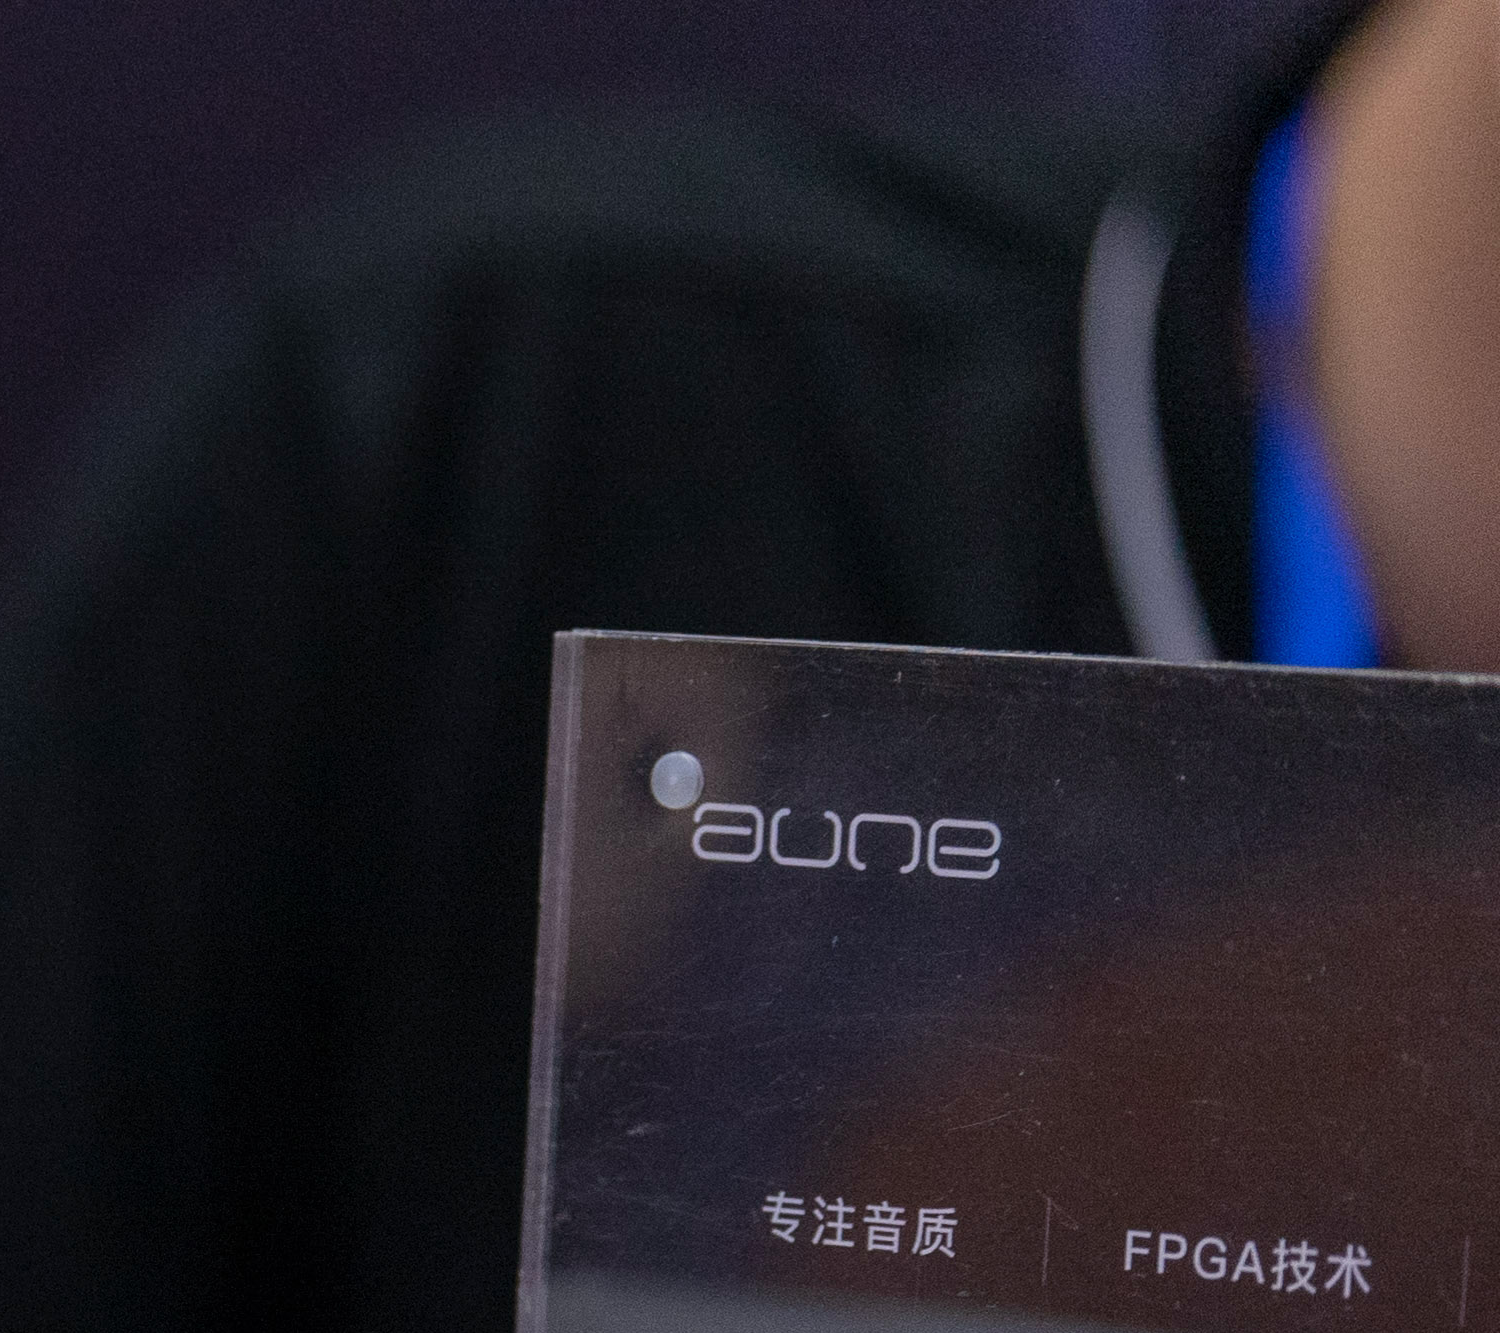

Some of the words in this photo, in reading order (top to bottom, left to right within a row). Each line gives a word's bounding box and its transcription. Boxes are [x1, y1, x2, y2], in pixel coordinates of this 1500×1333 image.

[691, 801, 1001, 880] aune
[760, 1189, 960, 1260] 专注音质
[1123, 1227, 1373, 1299] FPGA技术
